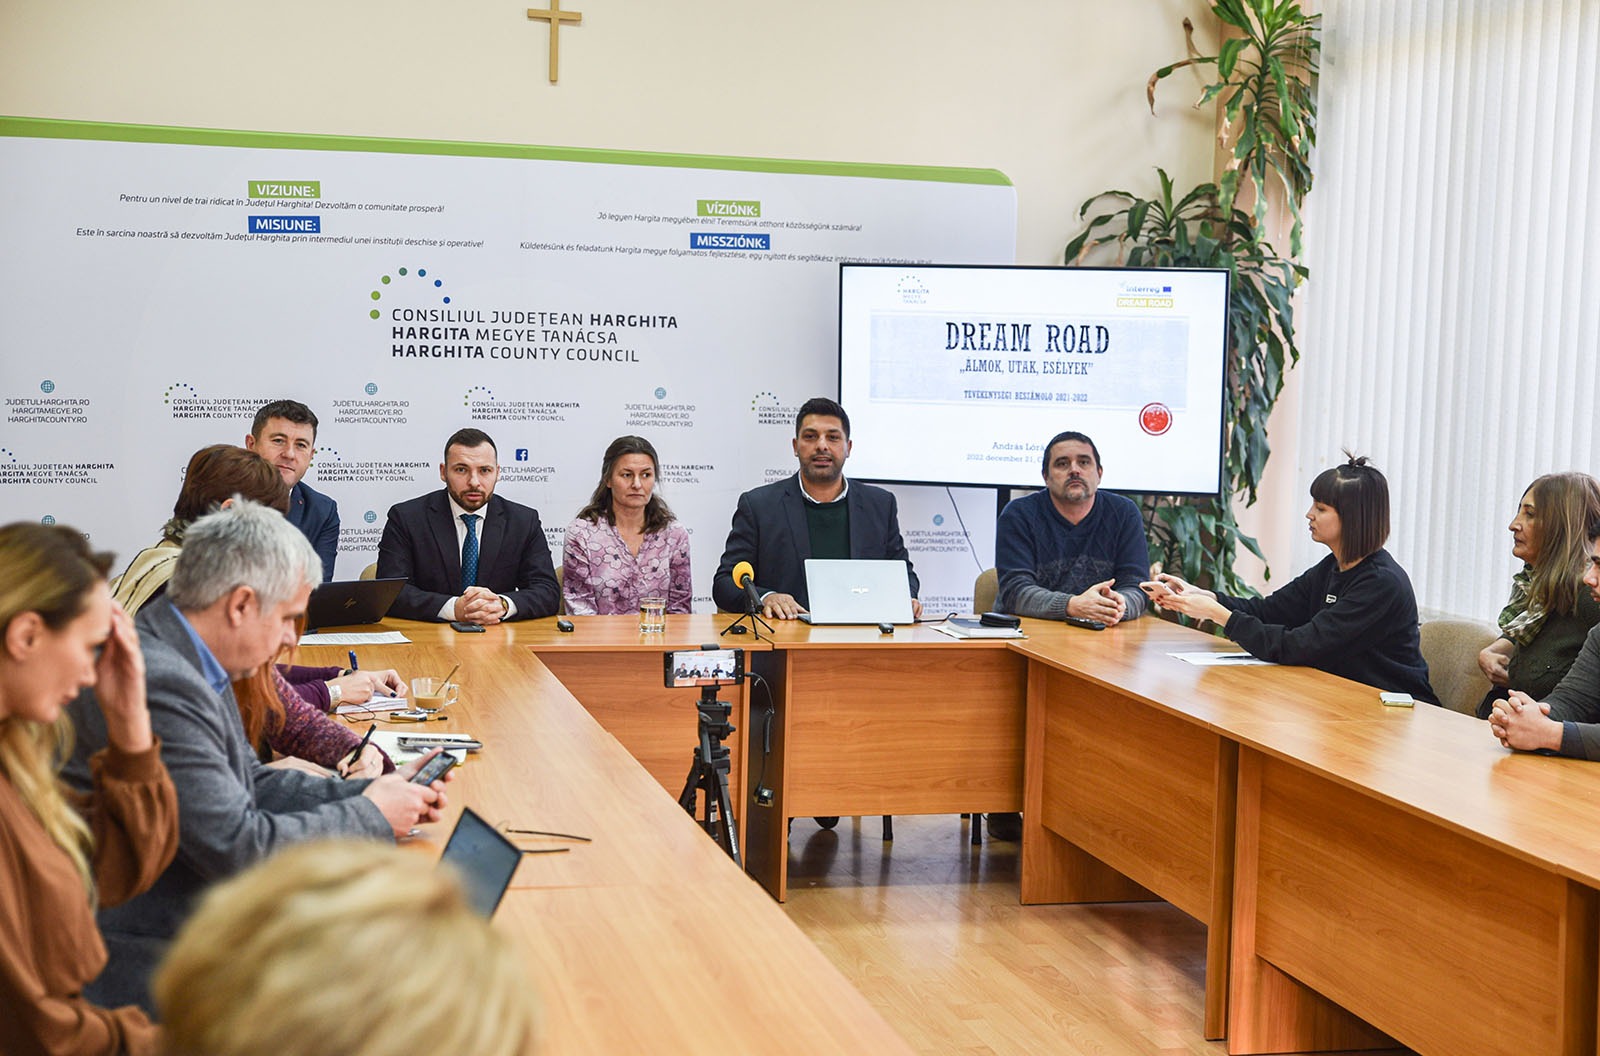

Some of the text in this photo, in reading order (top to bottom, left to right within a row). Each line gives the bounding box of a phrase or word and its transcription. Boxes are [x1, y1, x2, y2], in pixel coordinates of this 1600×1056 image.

[256, 184, 315, 197] VIZIUNE:
[119, 194, 148, 203] Pentru
[161, 196, 182, 204] nivel
[183, 197, 193, 205] de
[195, 198, 209, 206] trai
[209, 198, 235, 206] ridicat
[276, 199, 313, 209] Harghita!
[314, 200, 357, 210] Dezvoltăm
[364, 203, 408, 212] comunitate
[706, 201, 758, 216] VÍZIÓNK:
[256, 219, 316, 232] MISIUNE:
[597, 212, 862, 232] Jó legyen Hargita megyében élni! Teremtsünk otthont közösségünk számára!
[76, 228, 95, 236] Este
[106, 229, 136, 238] sarcina
[137, 230, 168, 239] noastră
[170, 231, 179, 239] să
[180, 231, 223, 240] dezvoltăm
[255, 233, 290, 243] Harghita
[291, 235, 307, 243] prin
[308, 235, 353, 244] intermediul
[404, 238, 438, 246] deschise
[446, 240, 484, 248] operative!
[697, 235, 766, 249] MISSZIÓNK:
[519, 242, 565, 251] Küldetésünk
[575, 244, 614, 253] feladatunk
[614, 246, 642, 255] Hargita
[642, 248, 668, 256] megye
[668, 248, 708, 257] folyamatos
[709, 249, 748, 259] fejlesztése,
[749, 252, 762, 261] egy
[763, 252, 787, 262] nyitott
[392, 308, 485, 323] CONSILIUL
[590, 313, 678, 329] HARGHITA
[392, 326, 618, 344] HARGITA MEGYE TANÁCSA
[945, 322, 1110, 354] DREAM ROAD
[392, 344, 639, 362] HARGHITA COUNTY COUNCIL
[1008, 360, 1039, 375] UTAK,
[332, 400, 410, 408] JUDETULHARGHITA.RO
[624, 403, 696, 411] JUDETULHARGHITA.RO
[338, 408, 403, 416] HARGITAMEGYE.RO
[334, 416, 407, 424] HARGHITACOUNTY.RO
[626, 420, 694, 428] HARGHITACOUNTY.RO
[1025, 443, 1044, 451] Lórá
